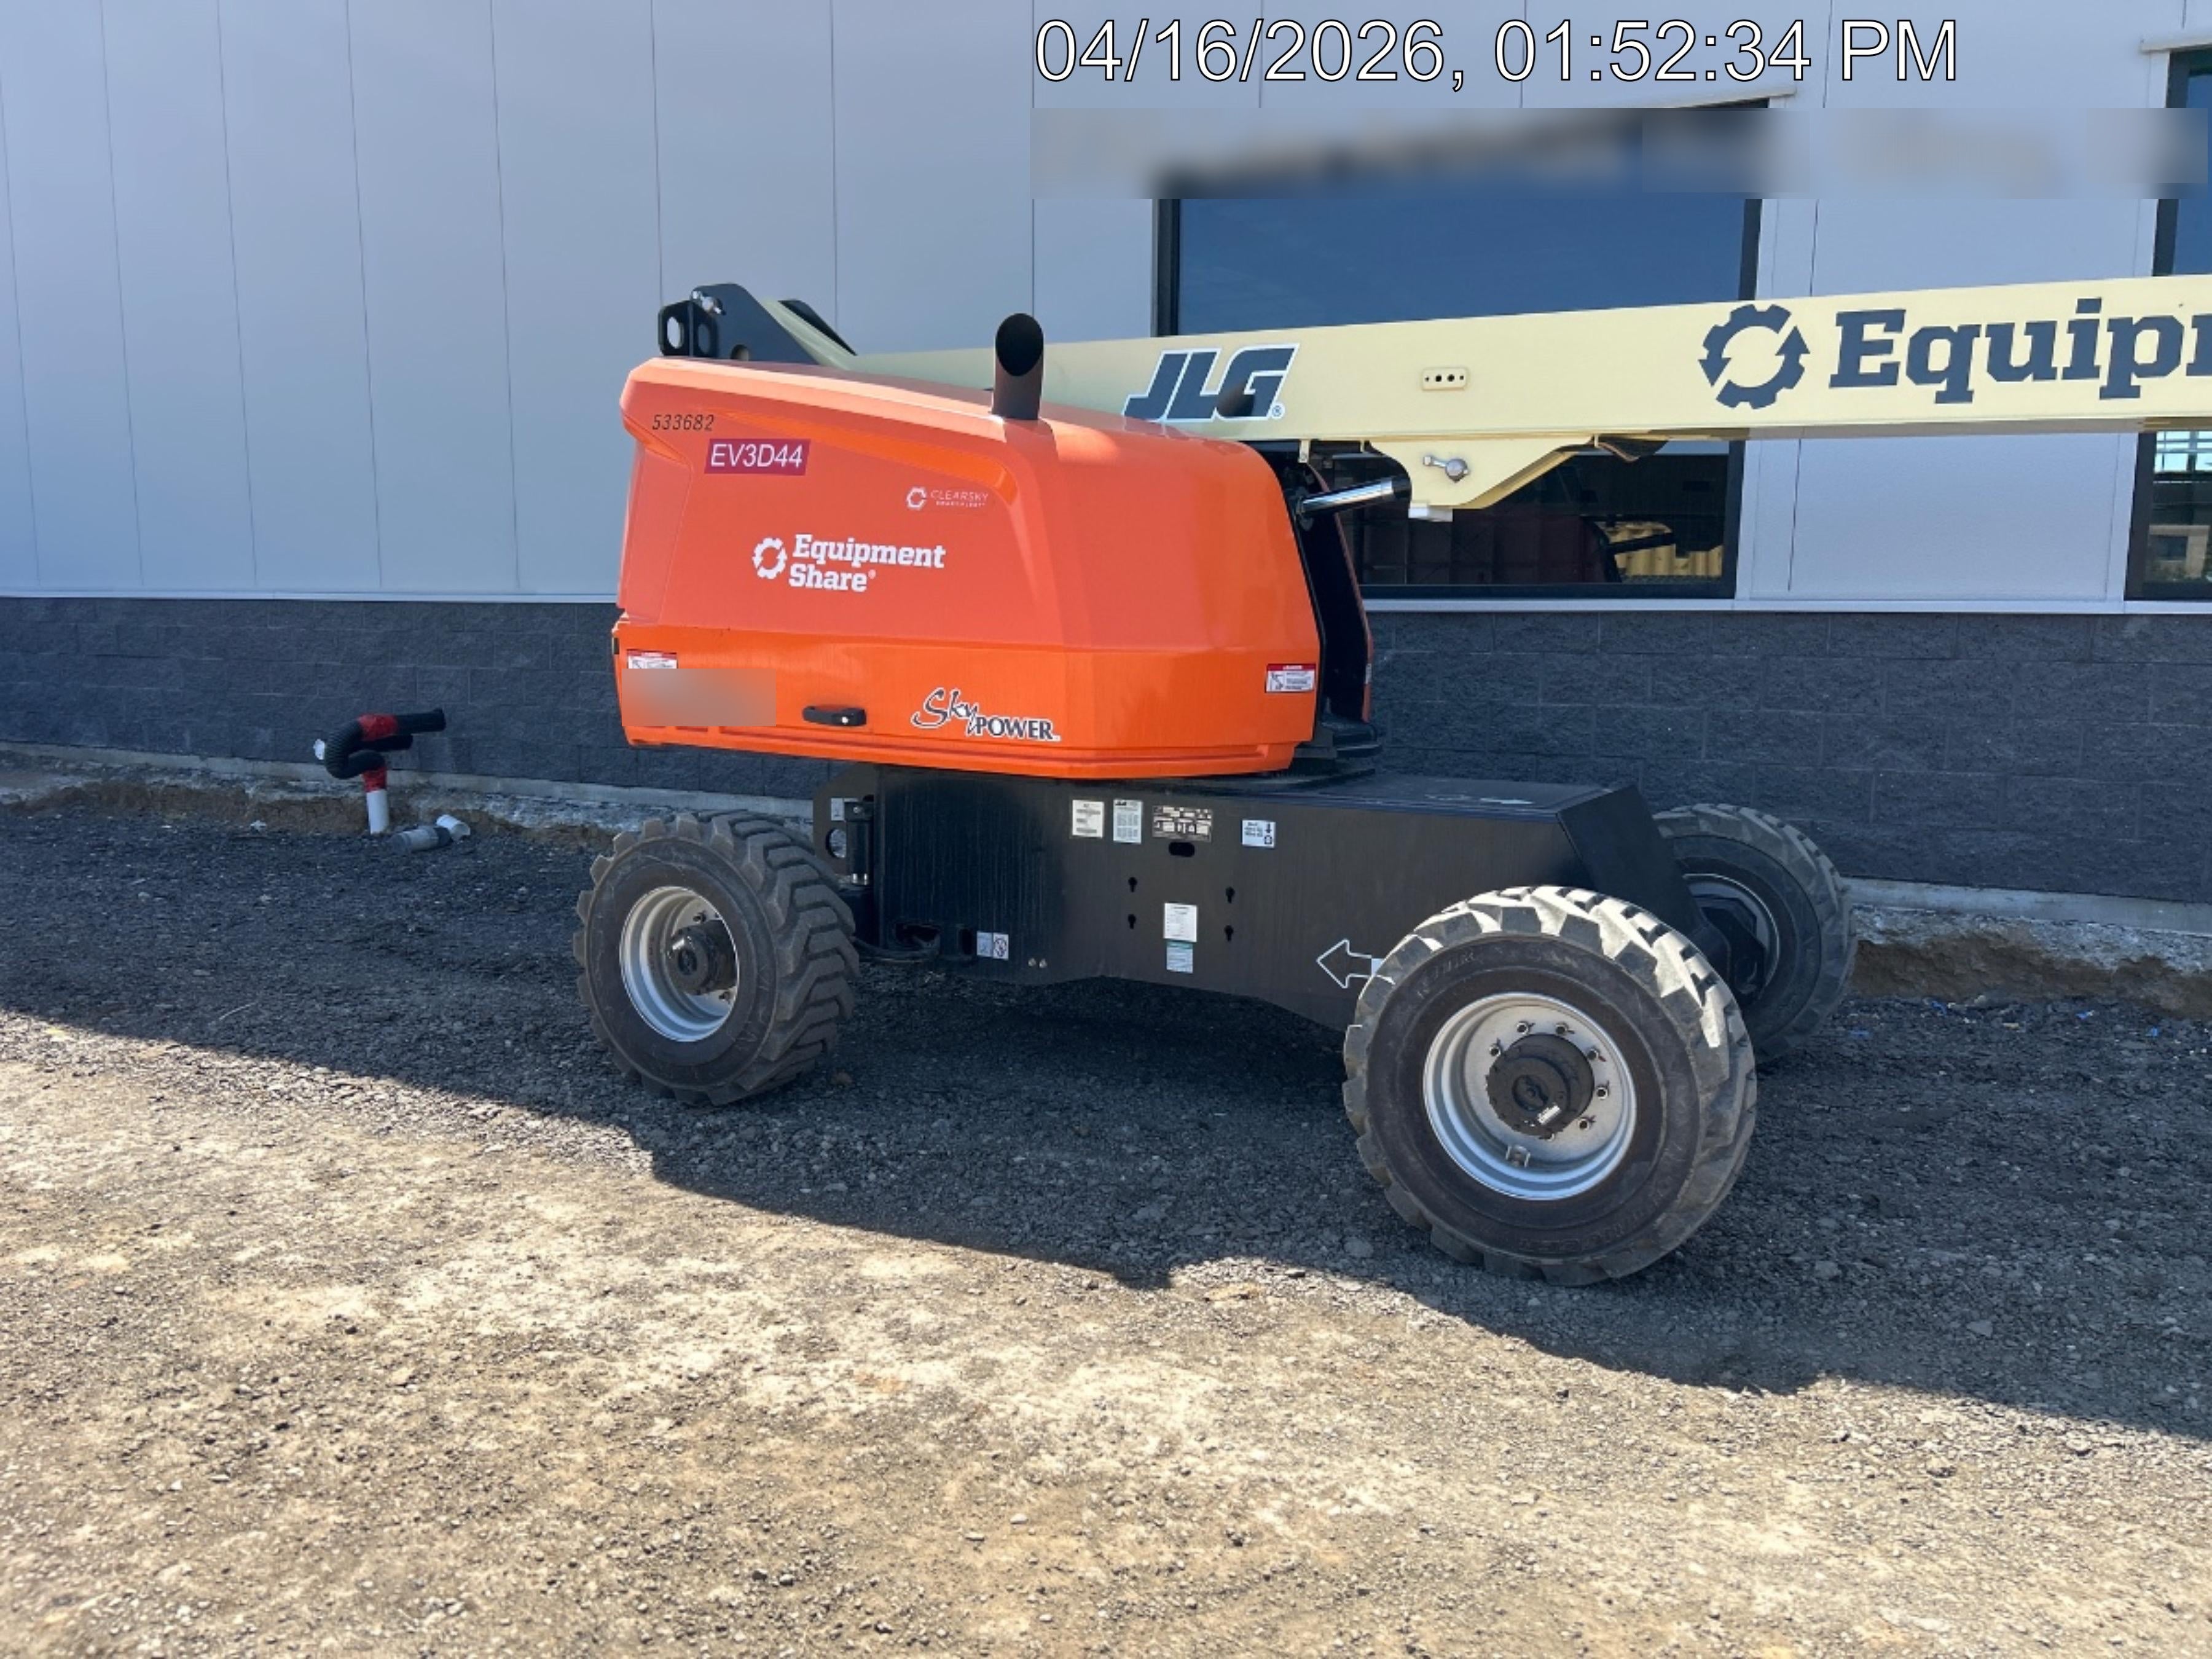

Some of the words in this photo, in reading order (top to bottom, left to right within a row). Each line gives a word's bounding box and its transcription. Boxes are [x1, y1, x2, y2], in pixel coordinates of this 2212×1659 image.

[1829, 297, 2212, 404] Equip
[652, 414, 715, 431] 533682
[710, 443, 803, 468] EV3D44
[792, 534, 947, 568] Equipment
[976, 716, 1054, 741] POWER
